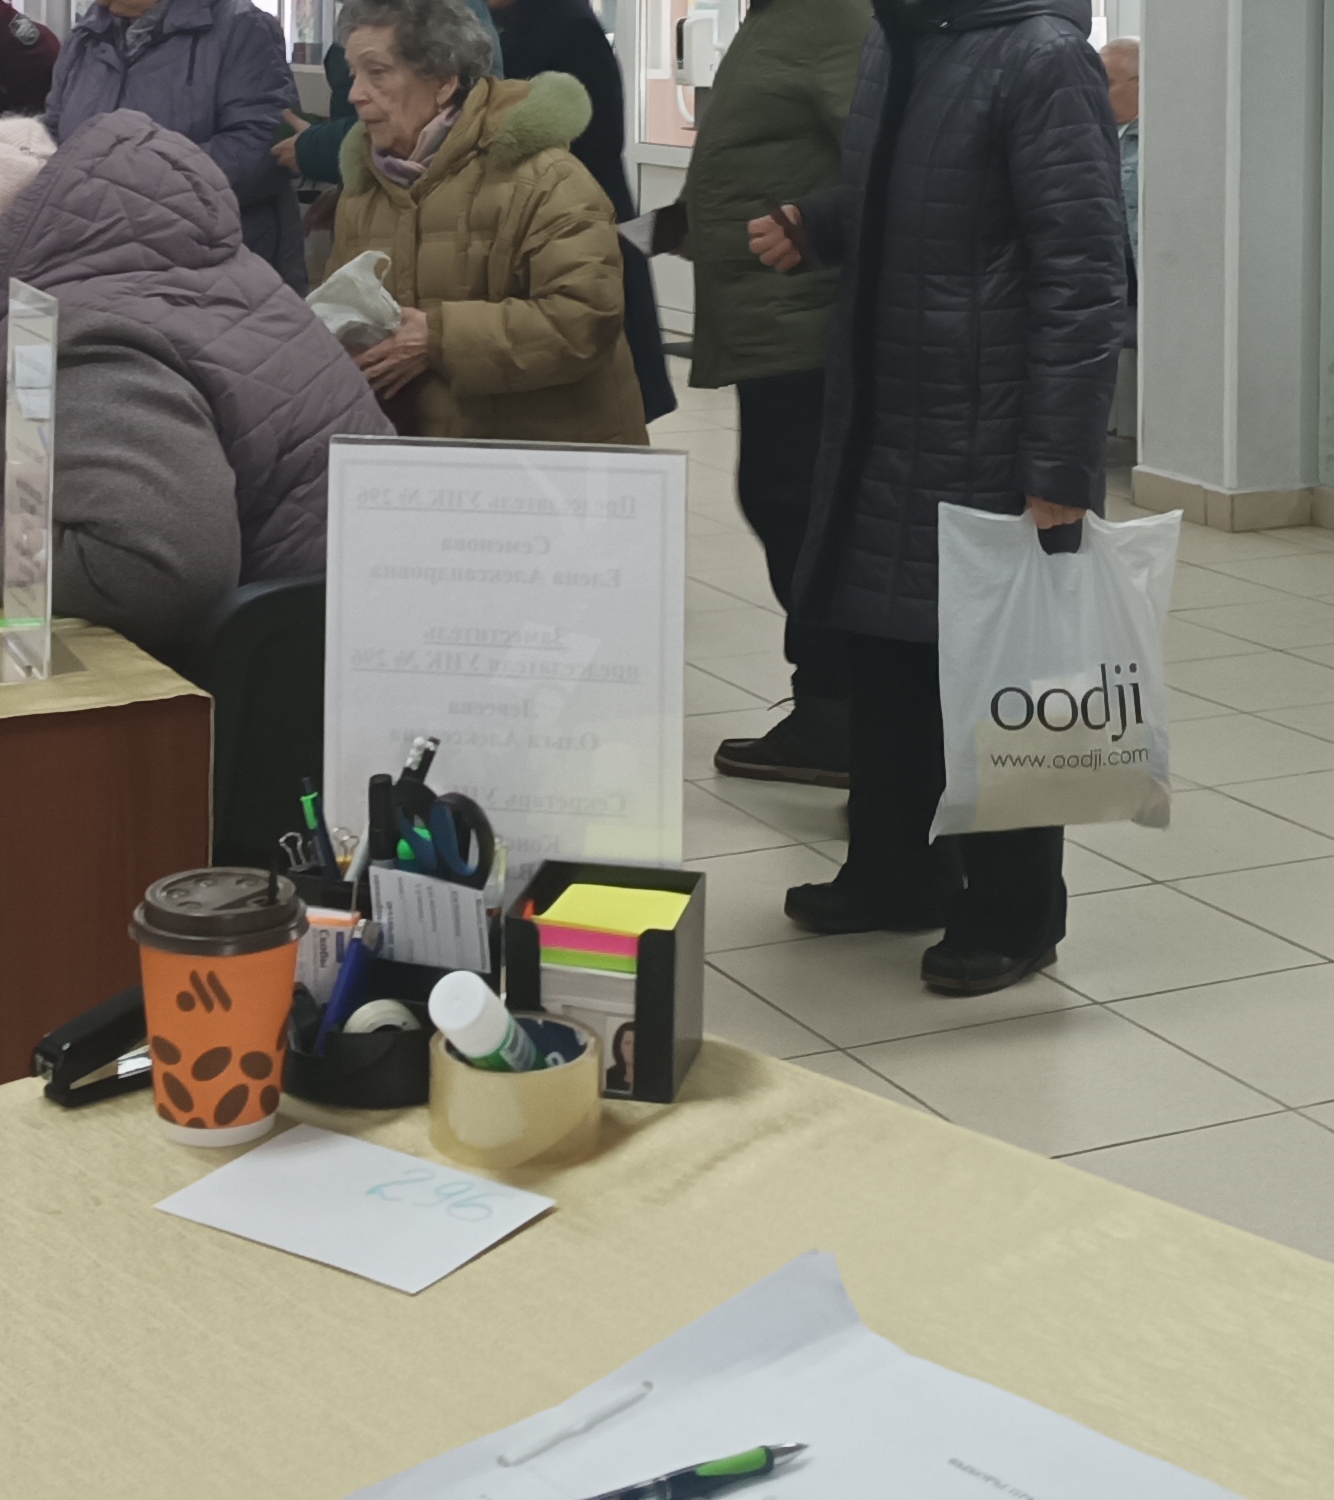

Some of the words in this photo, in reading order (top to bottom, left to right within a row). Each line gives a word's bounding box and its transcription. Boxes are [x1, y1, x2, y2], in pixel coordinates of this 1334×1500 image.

[990, 662, 1144, 743] oodji
[990, 746, 1149, 771] www.oodji.com
[365, 1168, 516, 1222] 296
